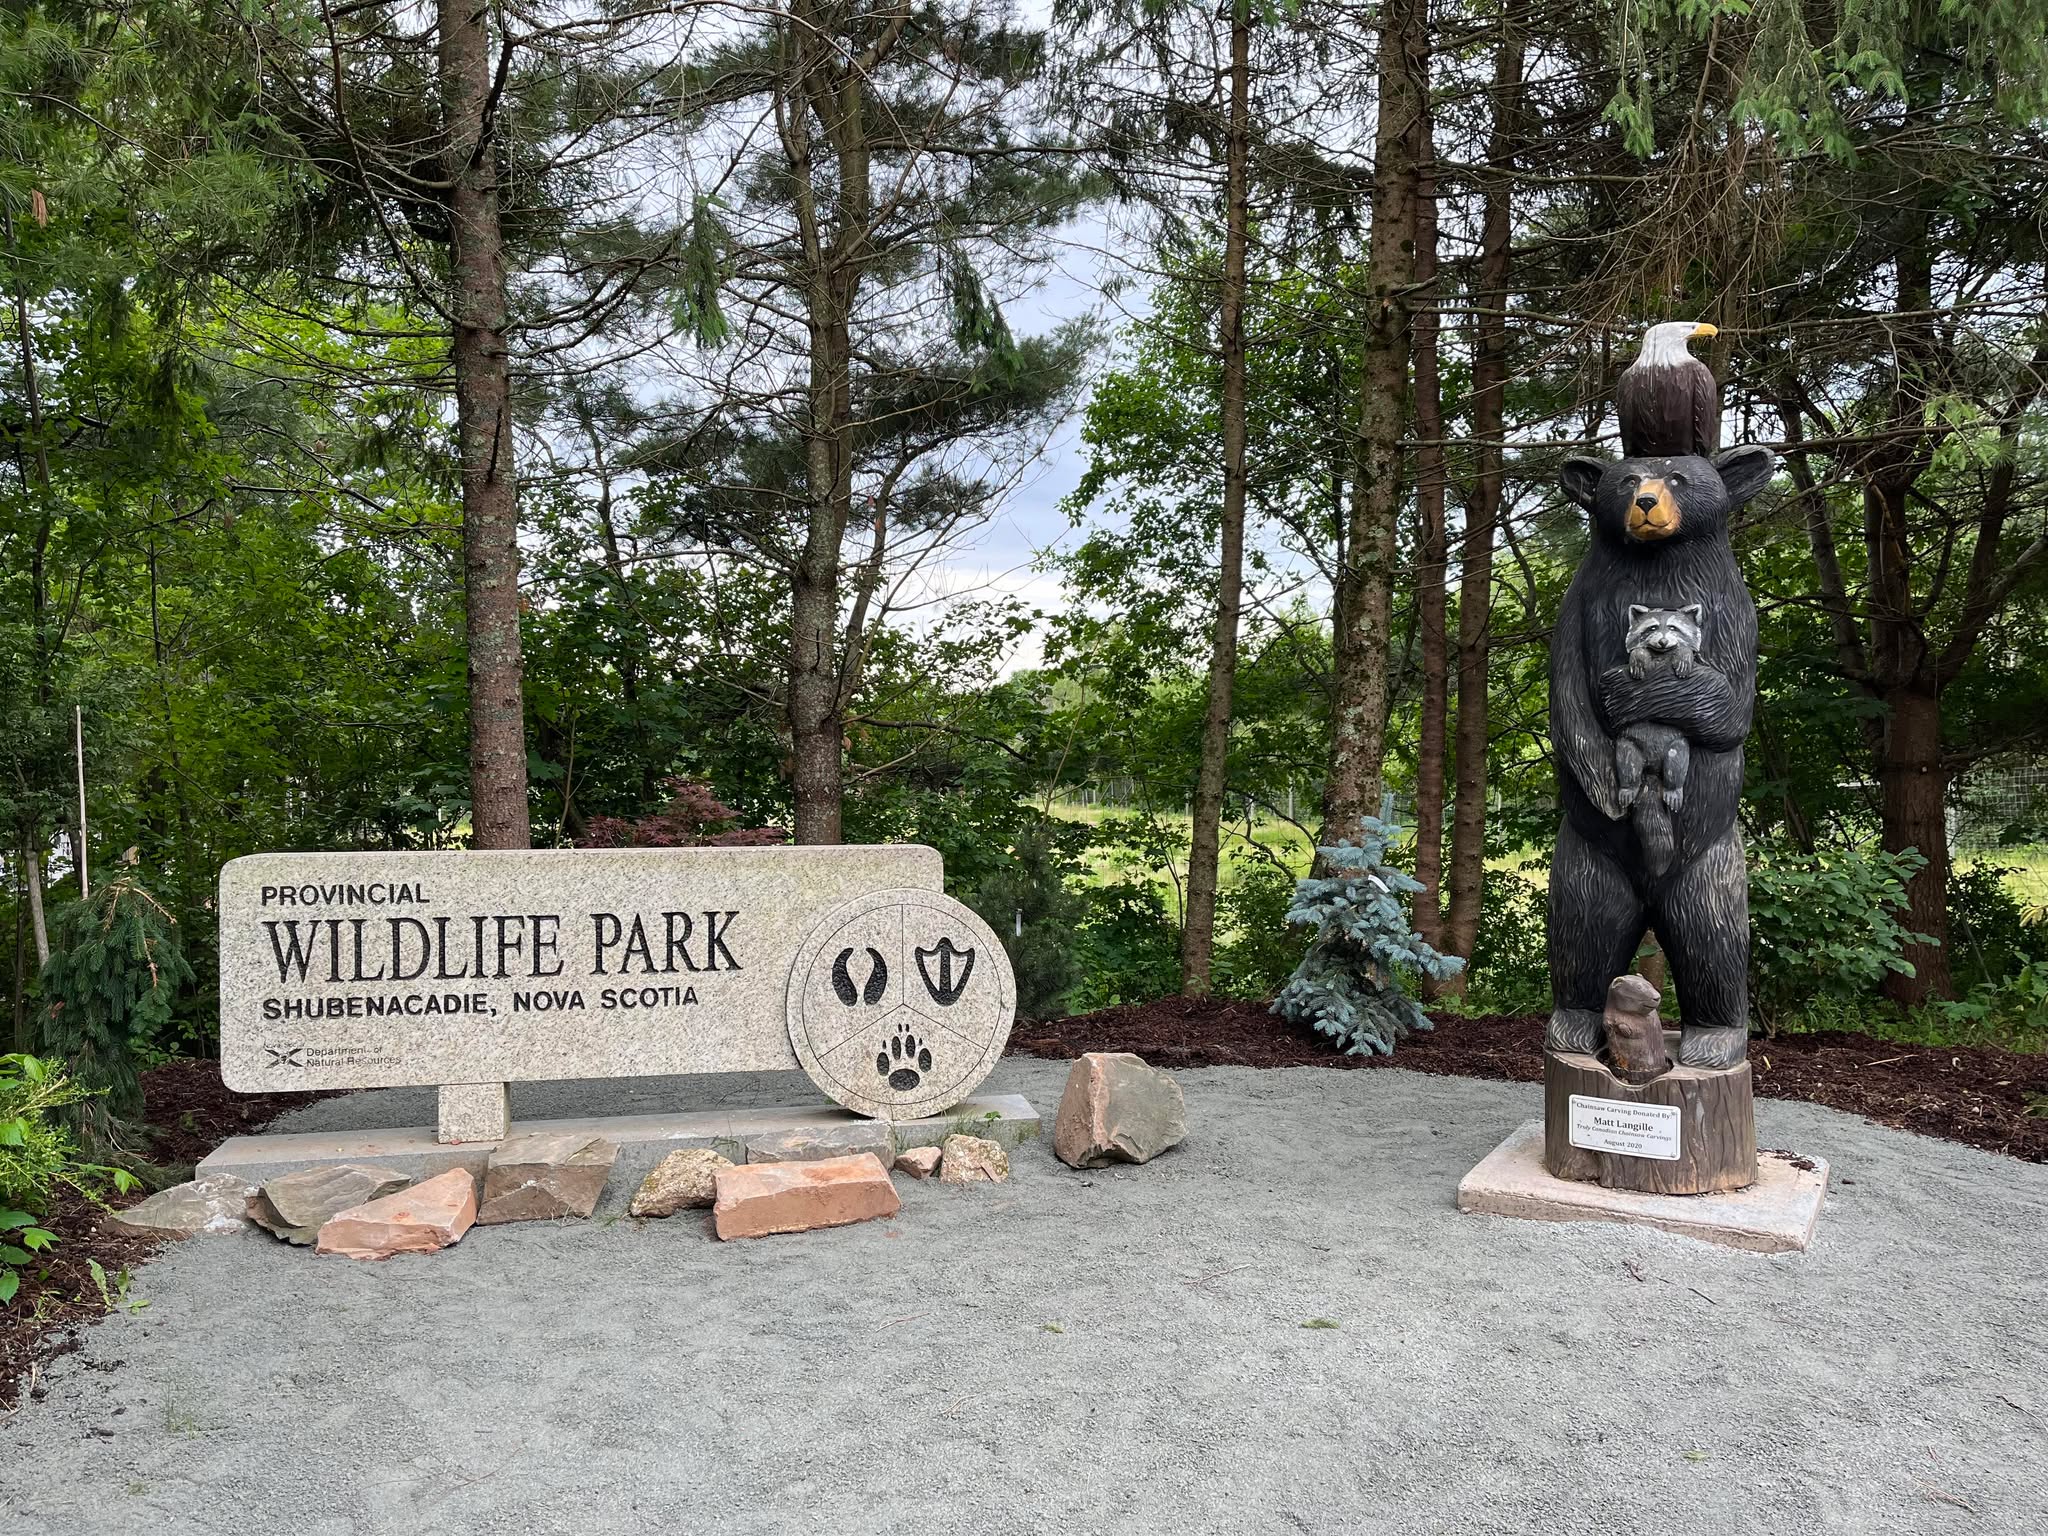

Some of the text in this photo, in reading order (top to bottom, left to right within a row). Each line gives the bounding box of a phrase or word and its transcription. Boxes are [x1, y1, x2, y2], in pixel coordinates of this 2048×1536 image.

[261, 883, 430, 906] PROVINCIAL
[261, 910, 743, 984] WILDLIFE PARK
[262, 986, 699, 1021] SHUBENACADIE, NOVA SCOTIA
[306, 1046, 366, 1057] Department
[306, 1056, 401, 1067] Natural Resources
[1576, 1102, 1605, 1111] Chainsaw
[1606, 1106, 1631, 1116] Carving
[1632, 1109, 1660, 1118] Donated
[1593, 1116, 1653, 1132] Matt Langille
[1577, 1123, 1672, 1142] Truly Canadian Chainsaw Carvings
[1604, 1139, 1625, 1148] August
